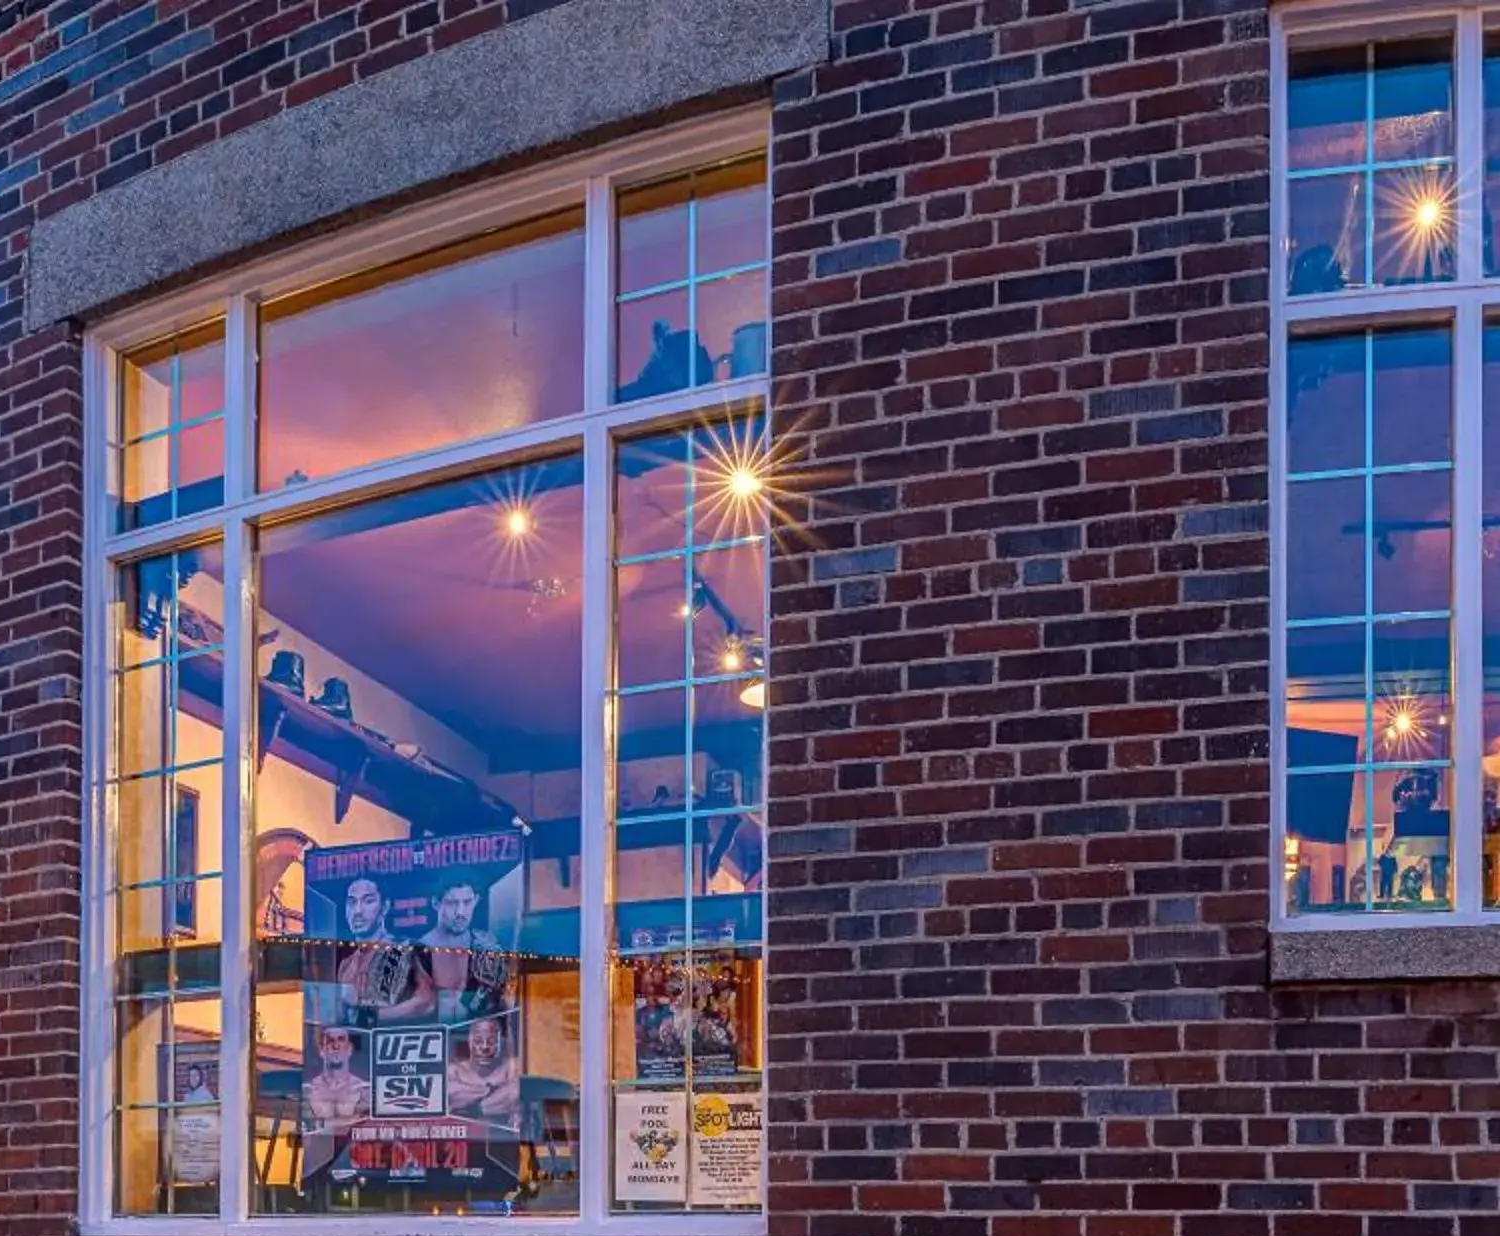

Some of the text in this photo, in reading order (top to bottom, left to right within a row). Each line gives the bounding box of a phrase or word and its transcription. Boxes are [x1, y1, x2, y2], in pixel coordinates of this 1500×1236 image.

[315, 846, 413, 881] HENDERSON
[425, 834, 514, 869] MELENDEZ
[378, 1034, 441, 1061] UFC
[401, 1065, 418, 1075] ON
[383, 1076, 434, 1099] SN
[641, 1105, 669, 1115] FREE
[641, 1119, 669, 1129] POOL
[632, 1161, 677, 1170] ALL DAY
[627, 1175, 680, 1183] MONDAYS
